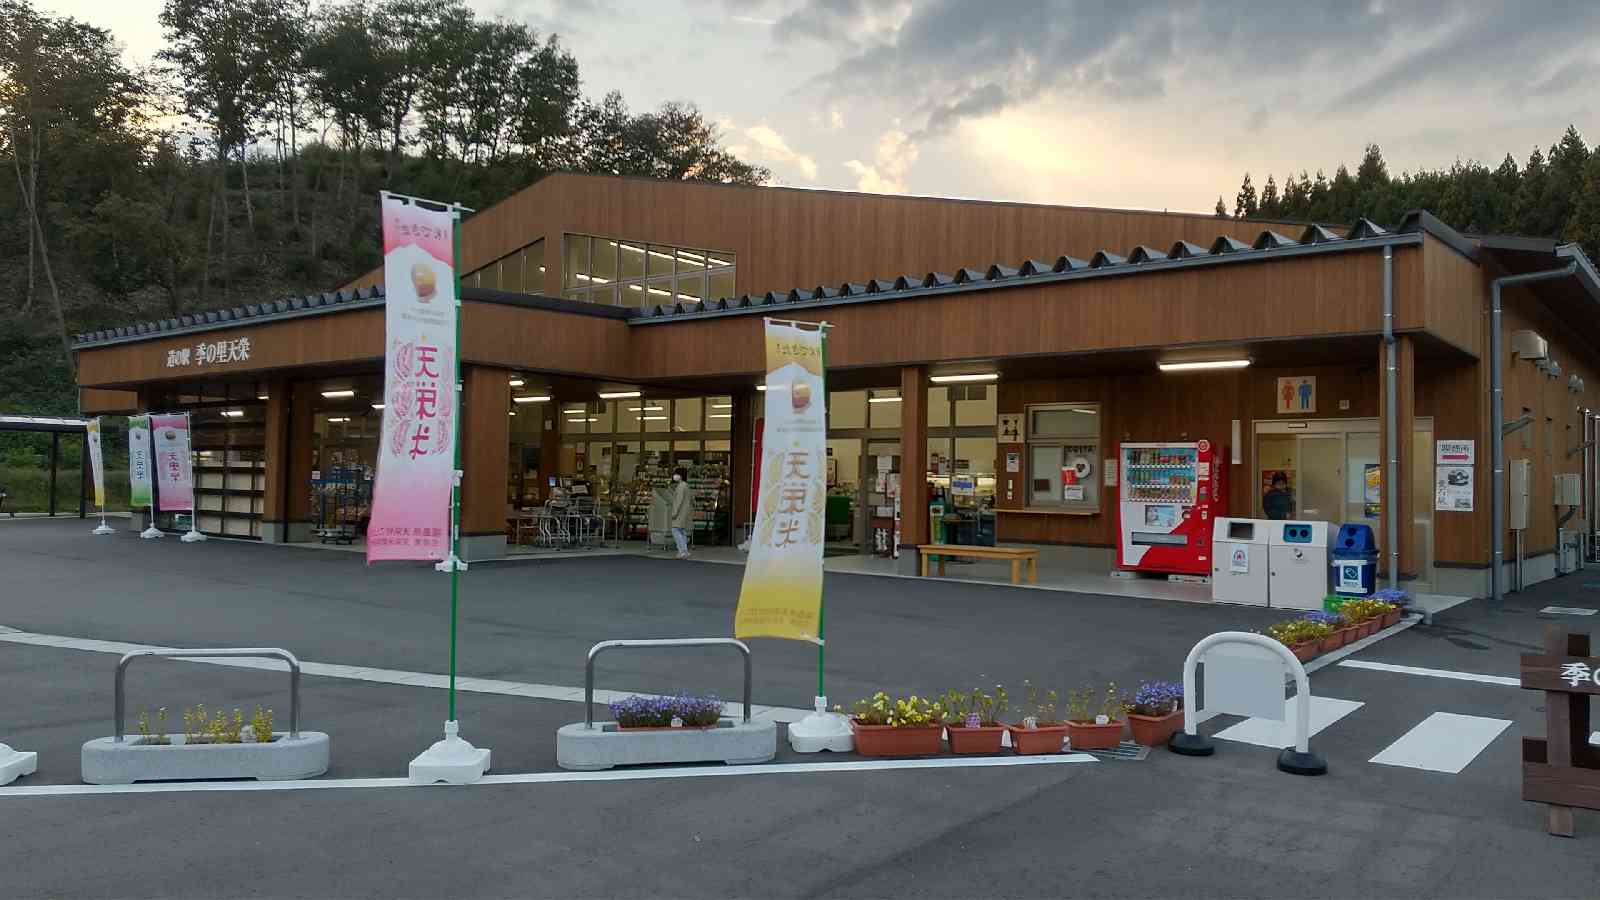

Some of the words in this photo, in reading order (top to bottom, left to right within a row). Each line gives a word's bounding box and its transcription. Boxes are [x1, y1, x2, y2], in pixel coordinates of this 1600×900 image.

[195, 336, 250, 366] 季の里天栄
[1560, 662, 1600, 688] 季
